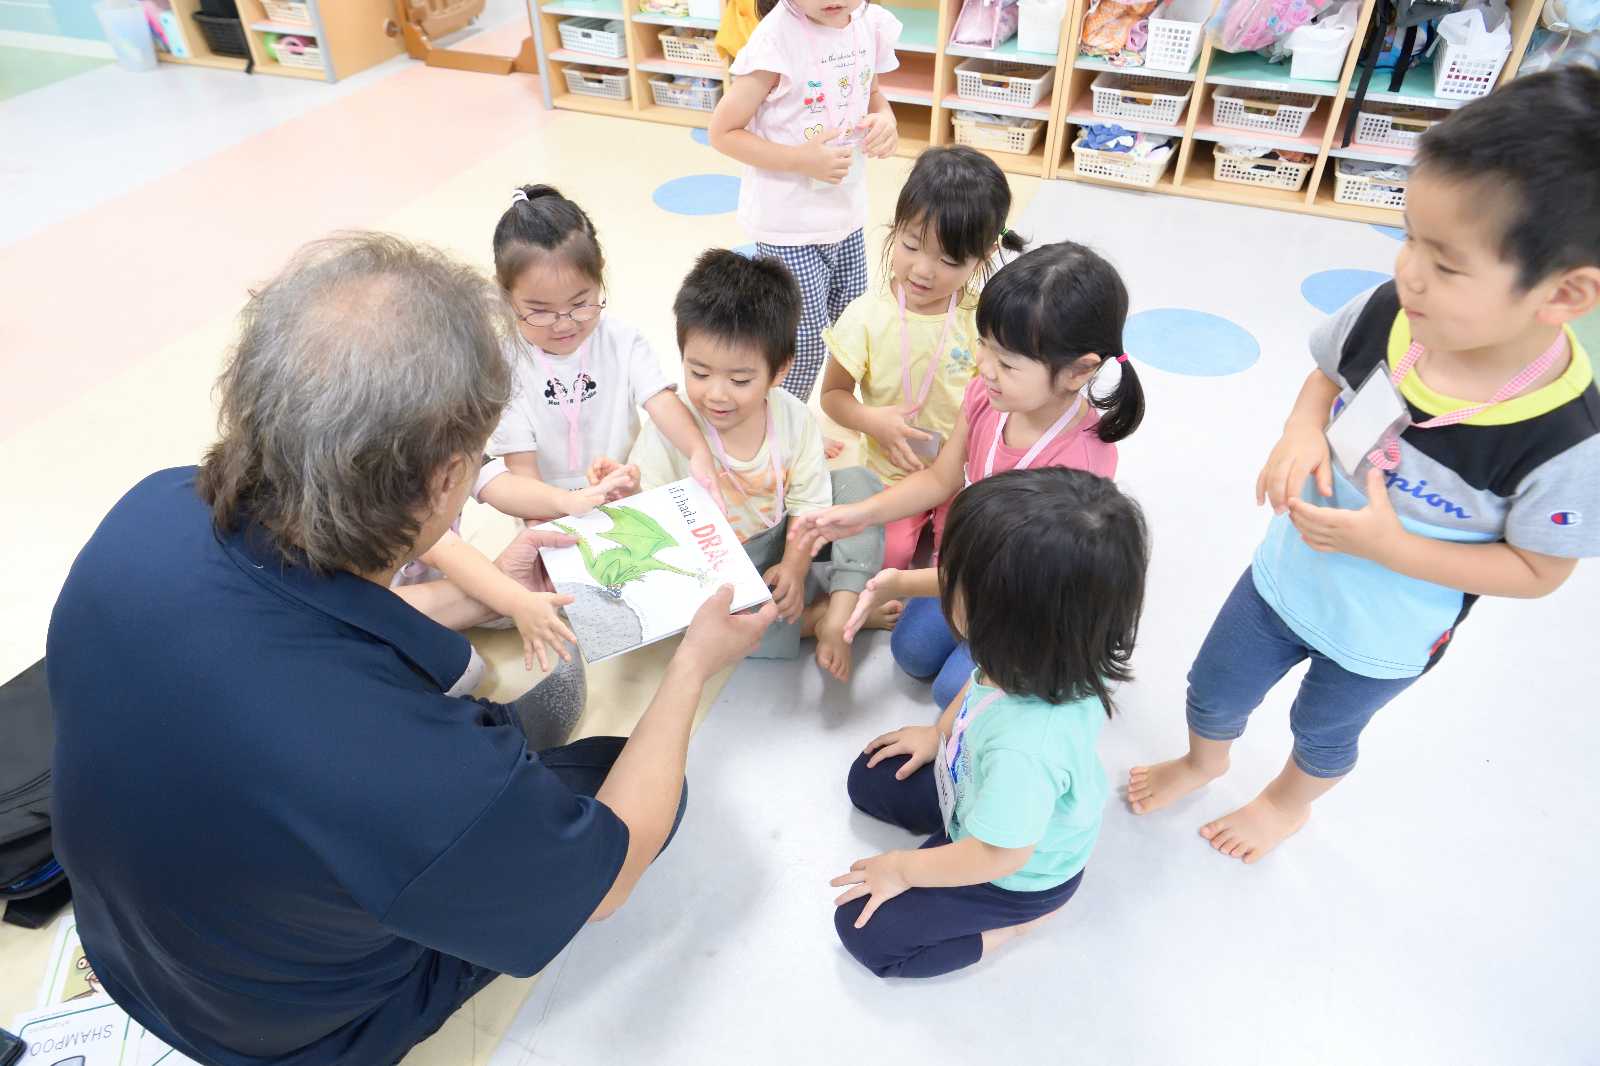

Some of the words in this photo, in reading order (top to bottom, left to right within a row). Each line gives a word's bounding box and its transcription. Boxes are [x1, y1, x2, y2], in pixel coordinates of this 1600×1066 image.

[668, 486, 684, 494] if
[1384, 469, 1472, 519] pion
[675, 498, 697, 518] had
[30, 1023, 114, 1057] SHAMPOO
